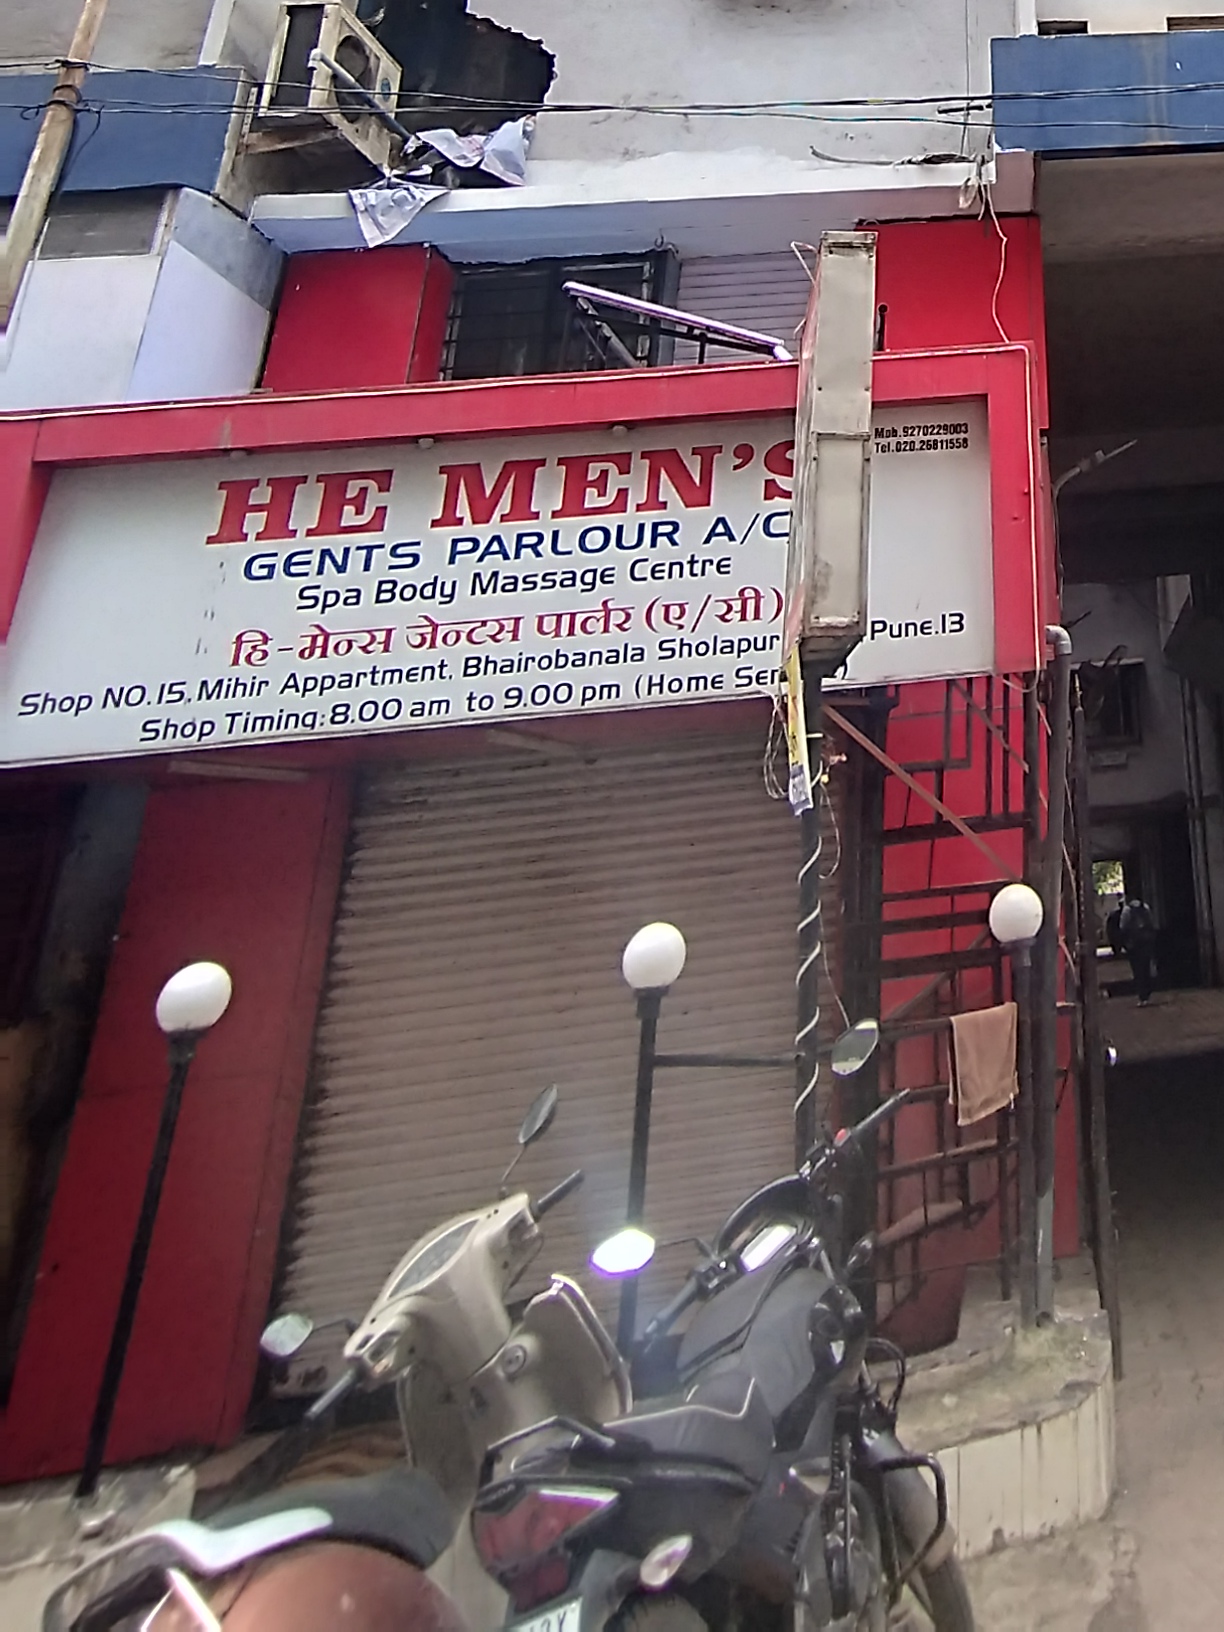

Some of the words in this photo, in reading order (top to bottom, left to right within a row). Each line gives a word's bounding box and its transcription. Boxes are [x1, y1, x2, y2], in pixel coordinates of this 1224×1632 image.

[205, 469, 394, 545] HE
[243, 541, 422, 581] GENTS
[447, 519, 681, 566] PARLOUR
[702, 510, 791, 548] A/C
[296, 584, 362, 614] Spa
[374, 575, 457, 605] Body
[469, 566, 616, 597] Massage
[629, 555, 732, 582] Centre
[536, 598, 635, 639] पार्लर
[18, 693, 93, 717] Shop
[196, 676, 270, 702] Mihir
[462, 643, 646, 678] Bhairobanala
[658, 634, 780, 661] Sholapur
[870, 612, 966, 641] Pune.13
[139, 718, 216, 742] Shop
[409, 699, 450, 718] am
[466, 691, 495, 713] to
[503, 682, 574, 709] 9.00
[581, 682, 621, 707] pm
[635, 674, 725, 699] (Home
[735, 665, 780, 689] Ser
